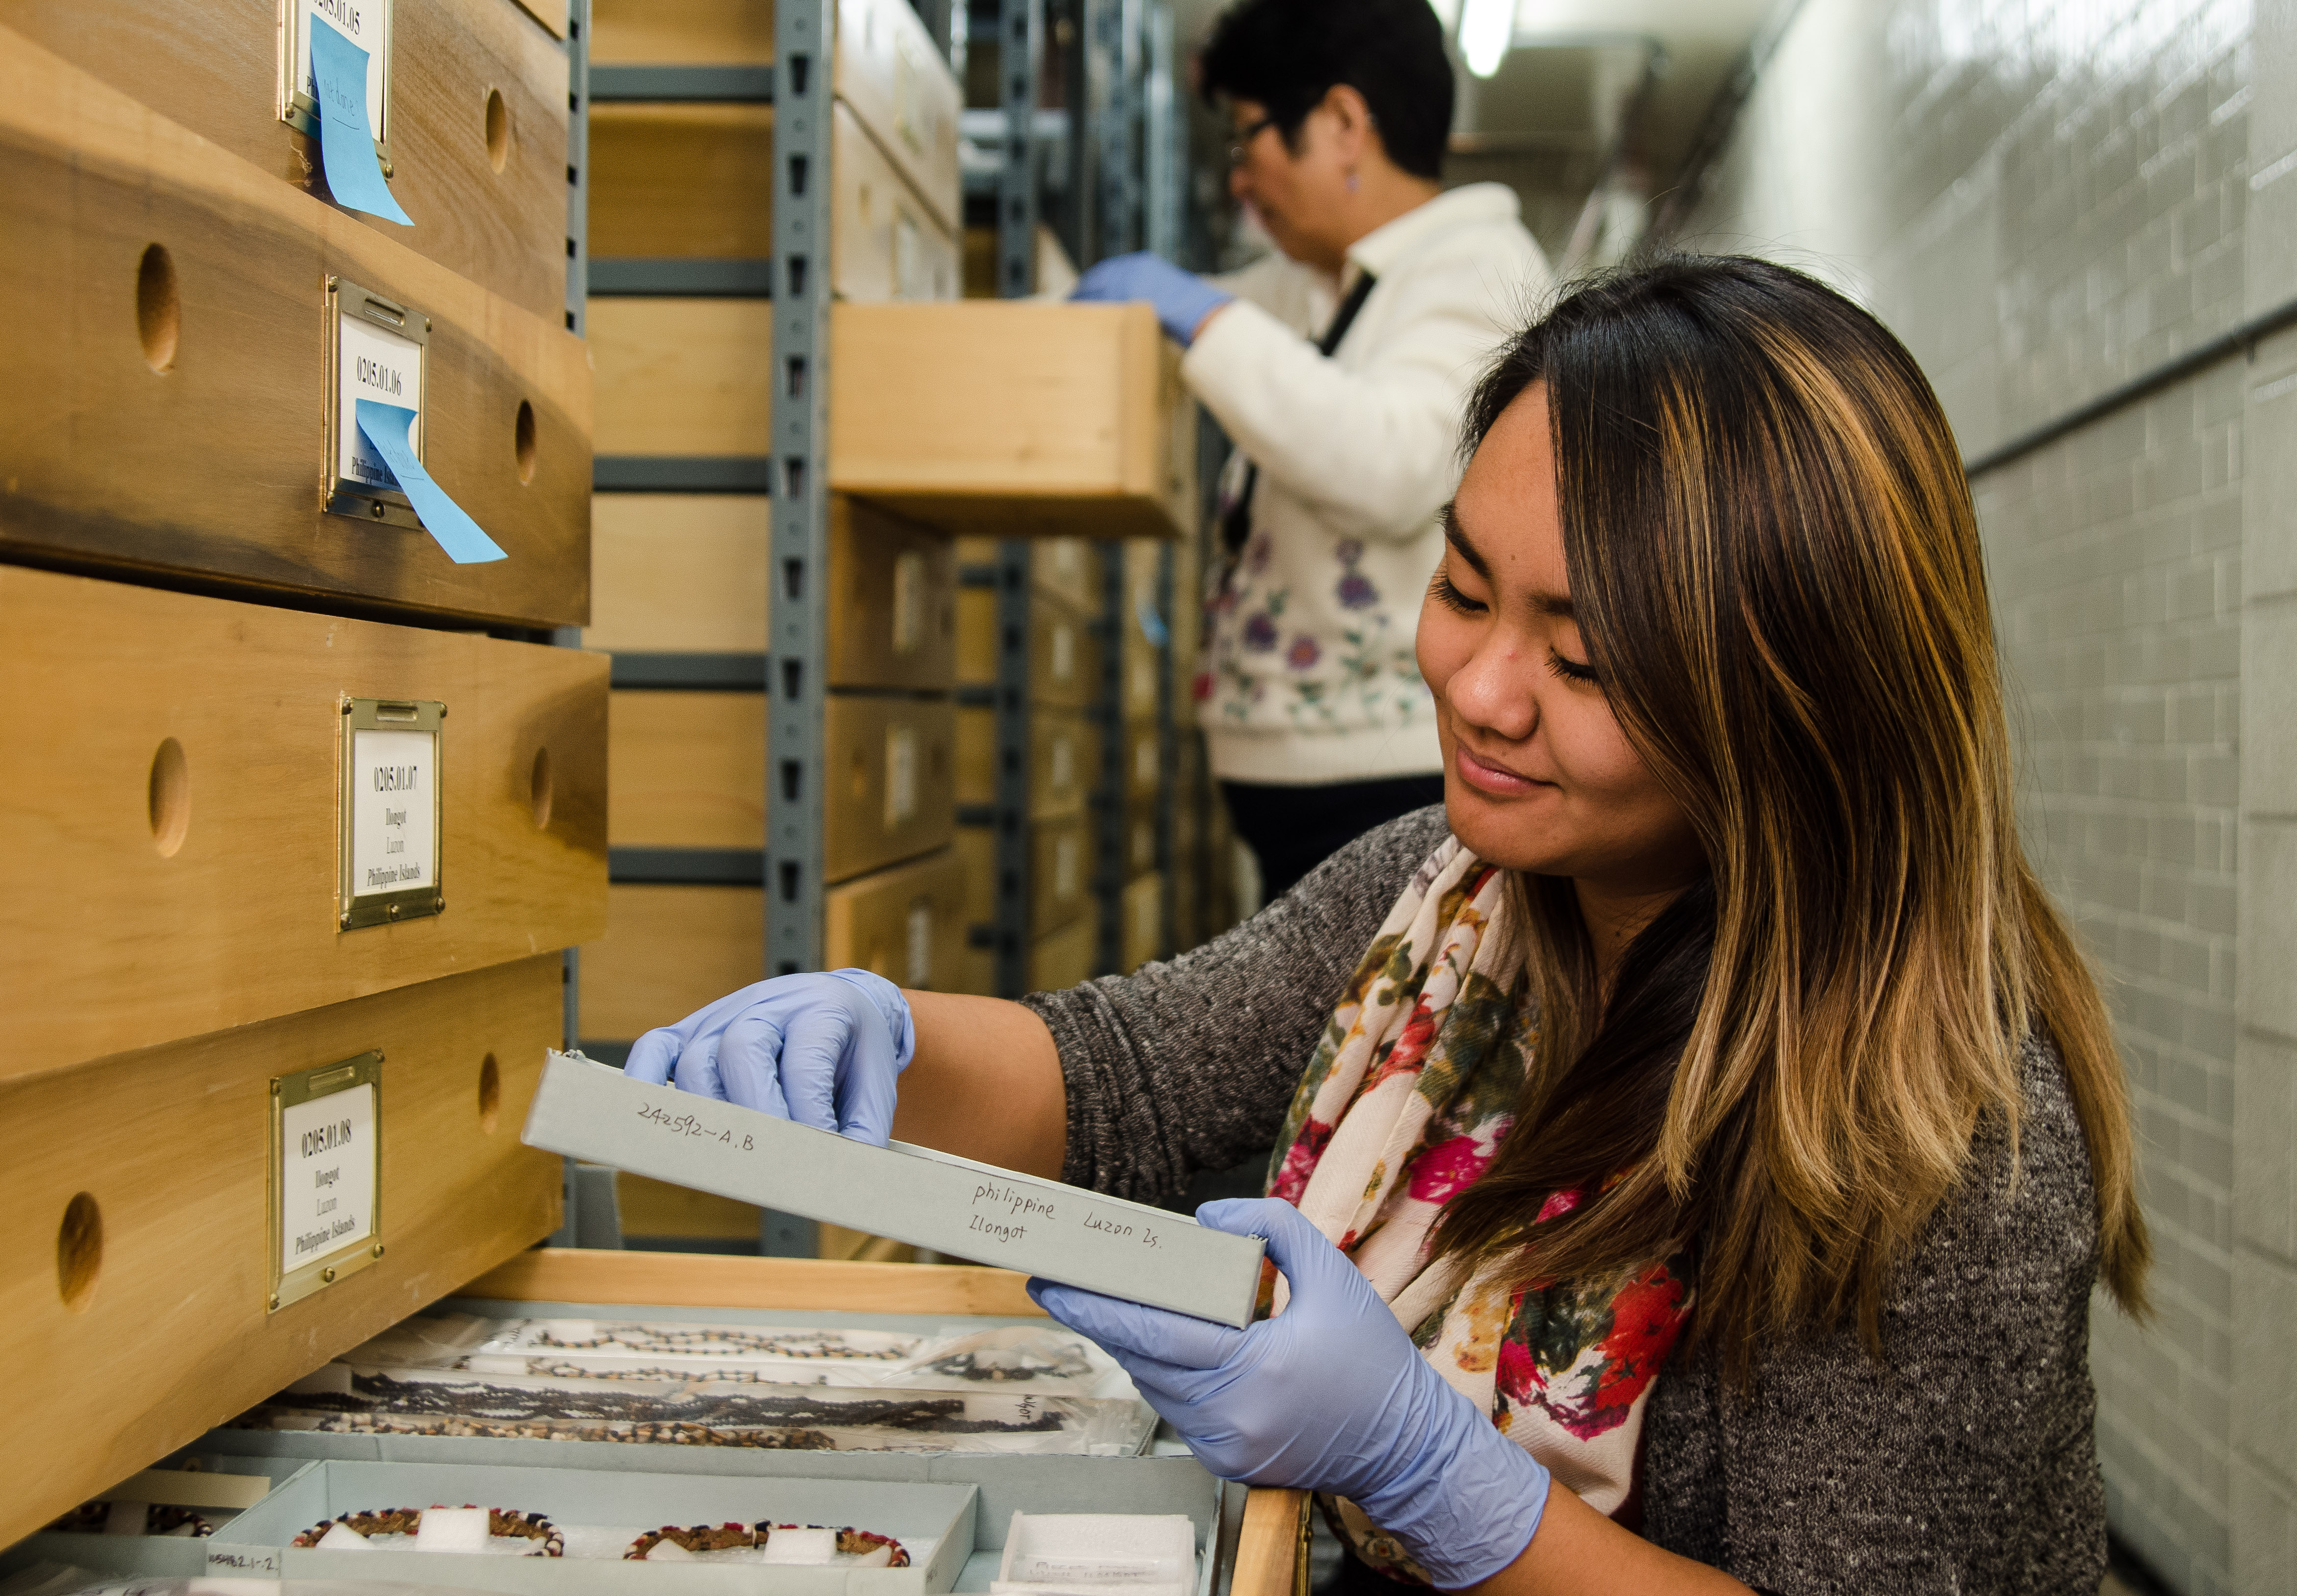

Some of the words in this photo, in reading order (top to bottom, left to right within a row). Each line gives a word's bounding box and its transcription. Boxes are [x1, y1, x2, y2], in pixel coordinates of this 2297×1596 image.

[314, 0, 360, 35] 5.01.05
[357, 356, 401, 397] 0205.01.06
[352, 456, 383, 485] Philippine
[374, 765, 417, 792] 0205.01.07
[387, 837, 404, 854] Luzon
[367, 866, 398, 889] Philippine
[399, 862, 420, 881] Islands
[301, 1118, 352, 1158] 0205.01.08
[969, 1214, 1027, 1242] Ilongot
[1083, 1211, 1133, 1236] Luzon
[295, 1226, 330, 1255] Philippine
